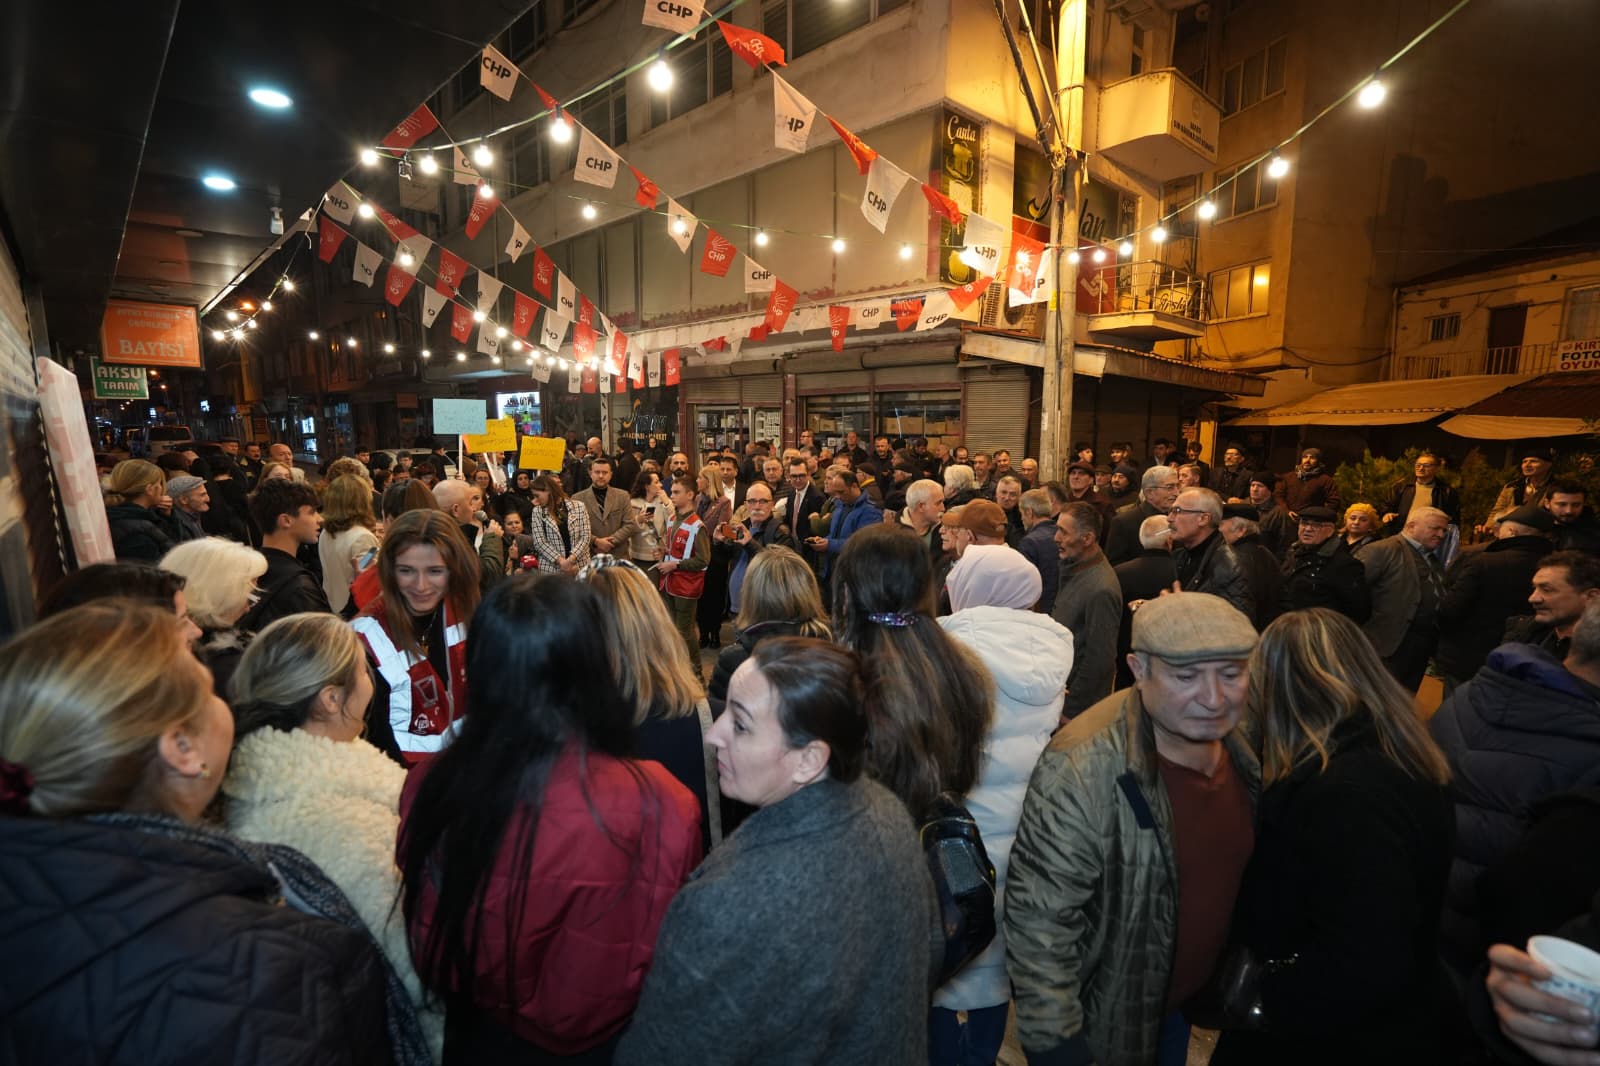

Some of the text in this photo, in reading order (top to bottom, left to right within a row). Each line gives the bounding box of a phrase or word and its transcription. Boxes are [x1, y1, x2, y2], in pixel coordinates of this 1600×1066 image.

[656, 1, 693, 19] CHP
[482, 56, 511, 79] CHP
[585, 156, 612, 172] CHP
[867, 190, 887, 213] CHP
[708, 250, 726, 262] CHP
[561, 296, 574, 309] CHP
[862, 308, 880, 318] CHP
[925, 313, 948, 325] CHP
[97, 367, 142, 379] AKSU
[101, 381, 140, 390] TARIM
